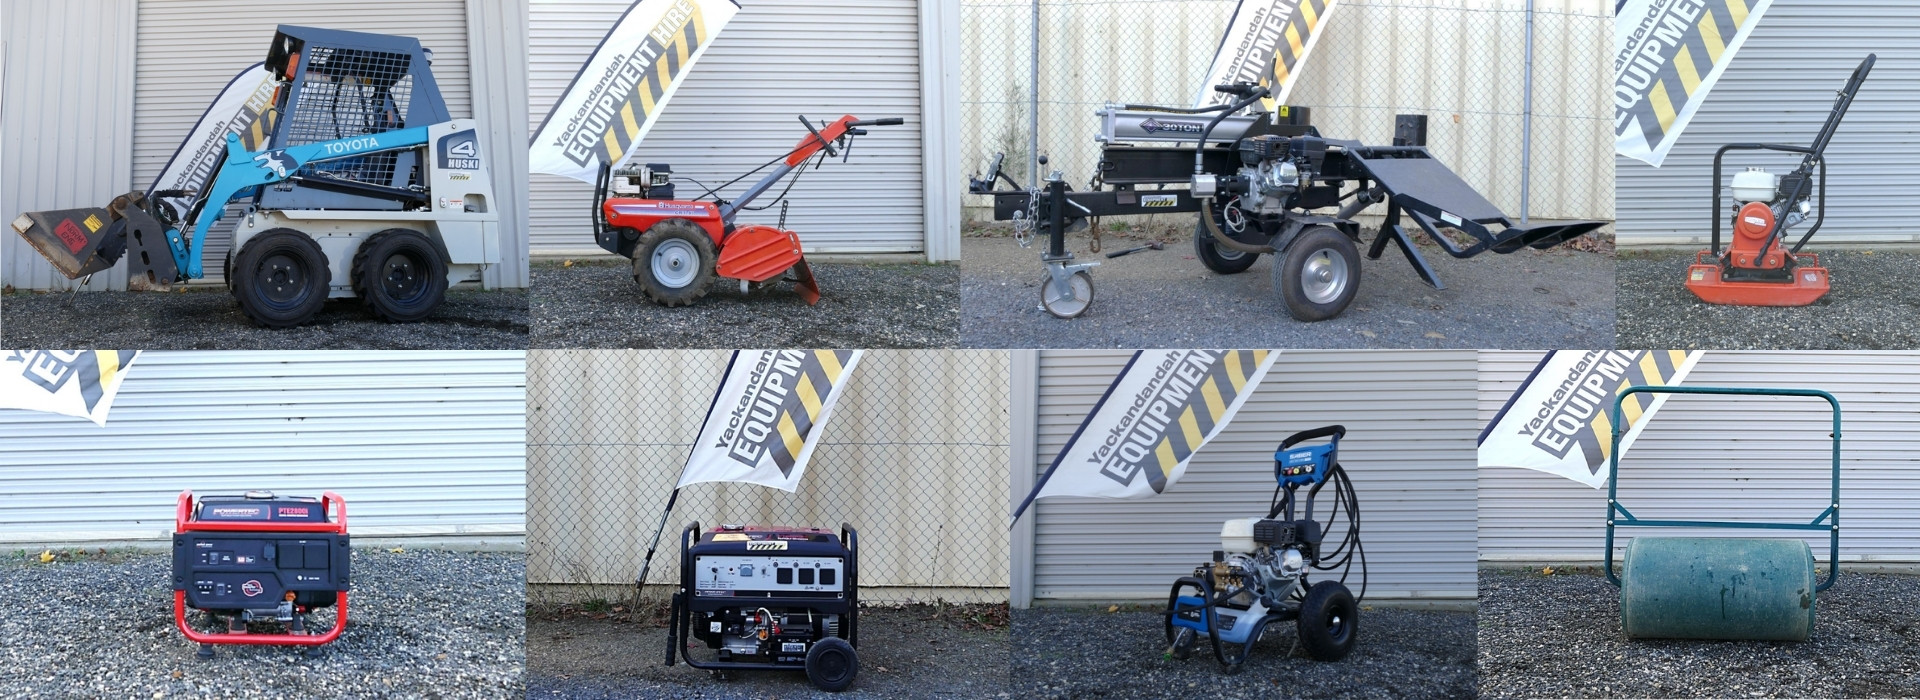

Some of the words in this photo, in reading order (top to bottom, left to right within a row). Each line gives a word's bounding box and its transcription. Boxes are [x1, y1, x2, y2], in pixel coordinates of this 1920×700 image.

[552, 53, 625, 149] Yackandandah
[566, 39, 657, 162] EQUIPMENT
[651, 0, 694, 46] HIRE
[169, 119, 226, 192] ackandandah
[324, 137, 379, 154] TOYOTA
[448, 158, 479, 169] HUSKI
[450, 139, 475, 157] 4
[715, 350, 773, 449] Yackandan
[1087, 350, 1182, 465] Yackandandah
[1104, 350, 1224, 480] EQUIPMEN
